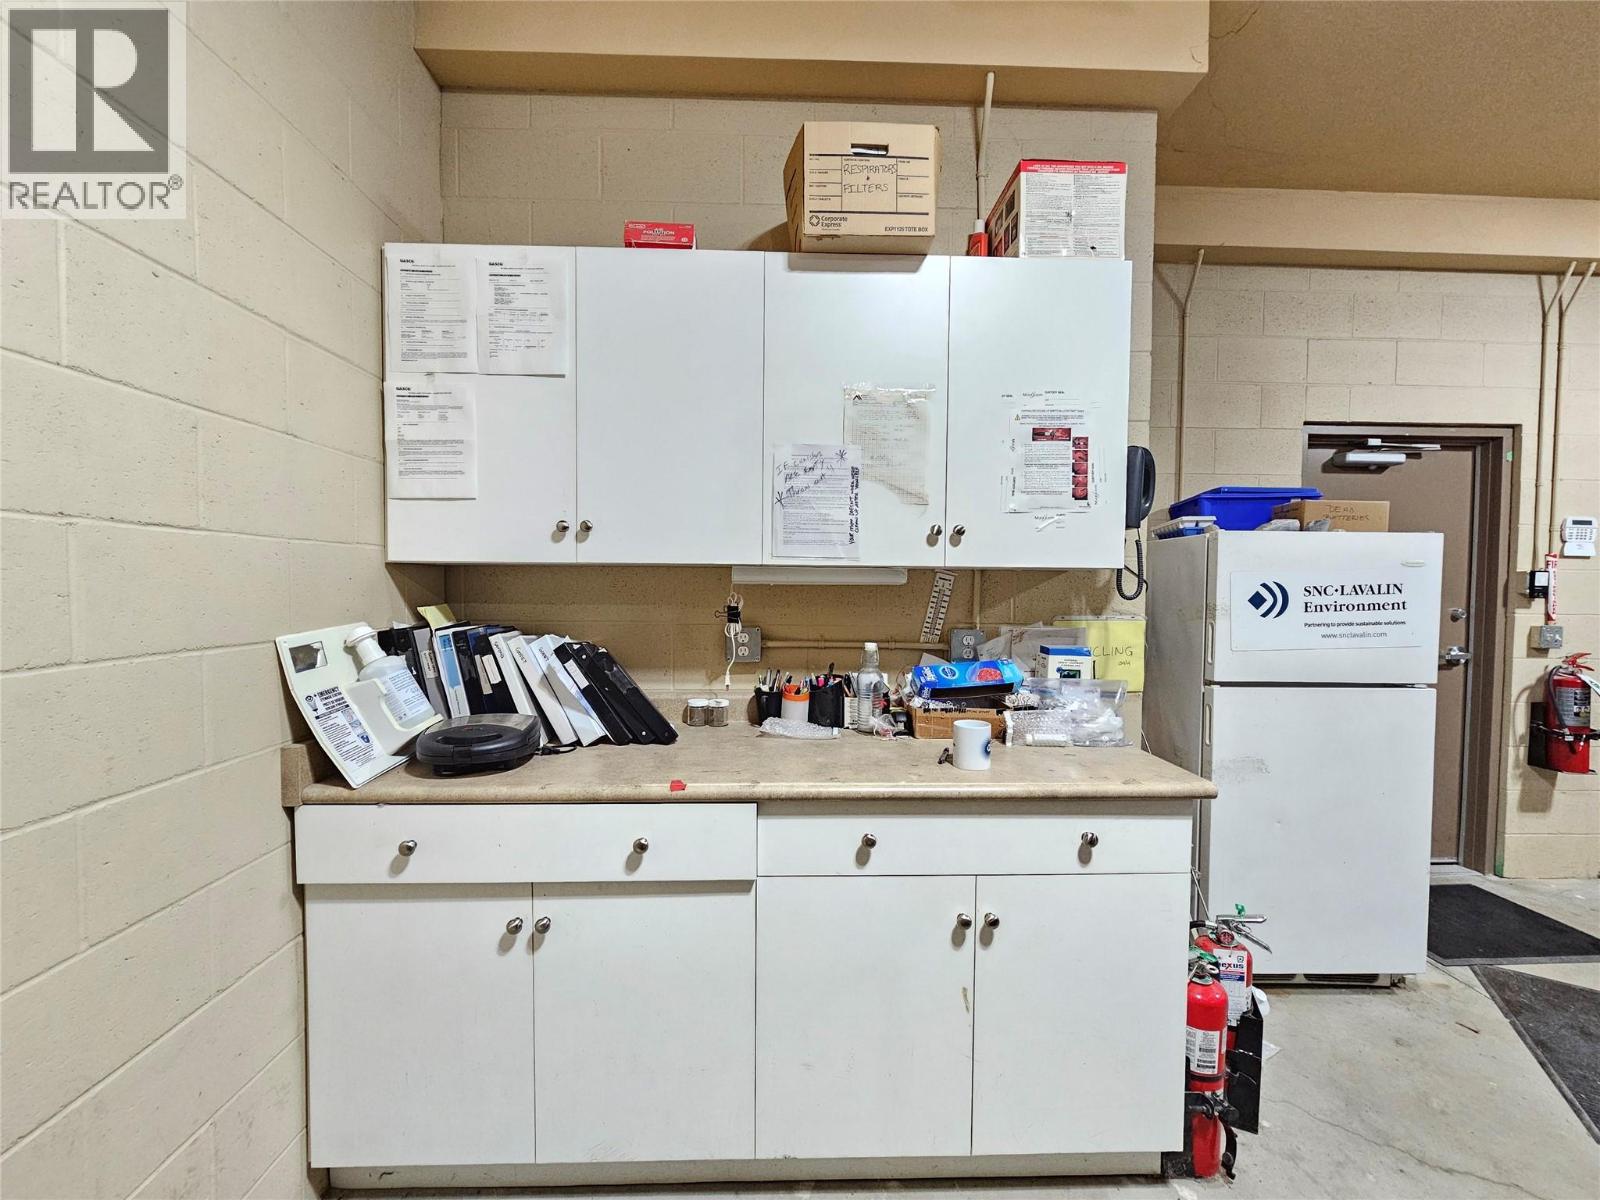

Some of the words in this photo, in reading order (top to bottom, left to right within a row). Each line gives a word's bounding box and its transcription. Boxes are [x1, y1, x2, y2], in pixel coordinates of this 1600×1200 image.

[843, 163, 897, 175] RESPIRATORS
[843, 183, 889, 194] FILTERS
[821, 215, 848, 223] Corporate
[1303, 600, 1407, 614] Environment
[1304, 621, 1330, 629] Partnering
[1321, 630, 1387, 639] www.snclavalin.com
[1090, 645, 1133, 658] CLING
